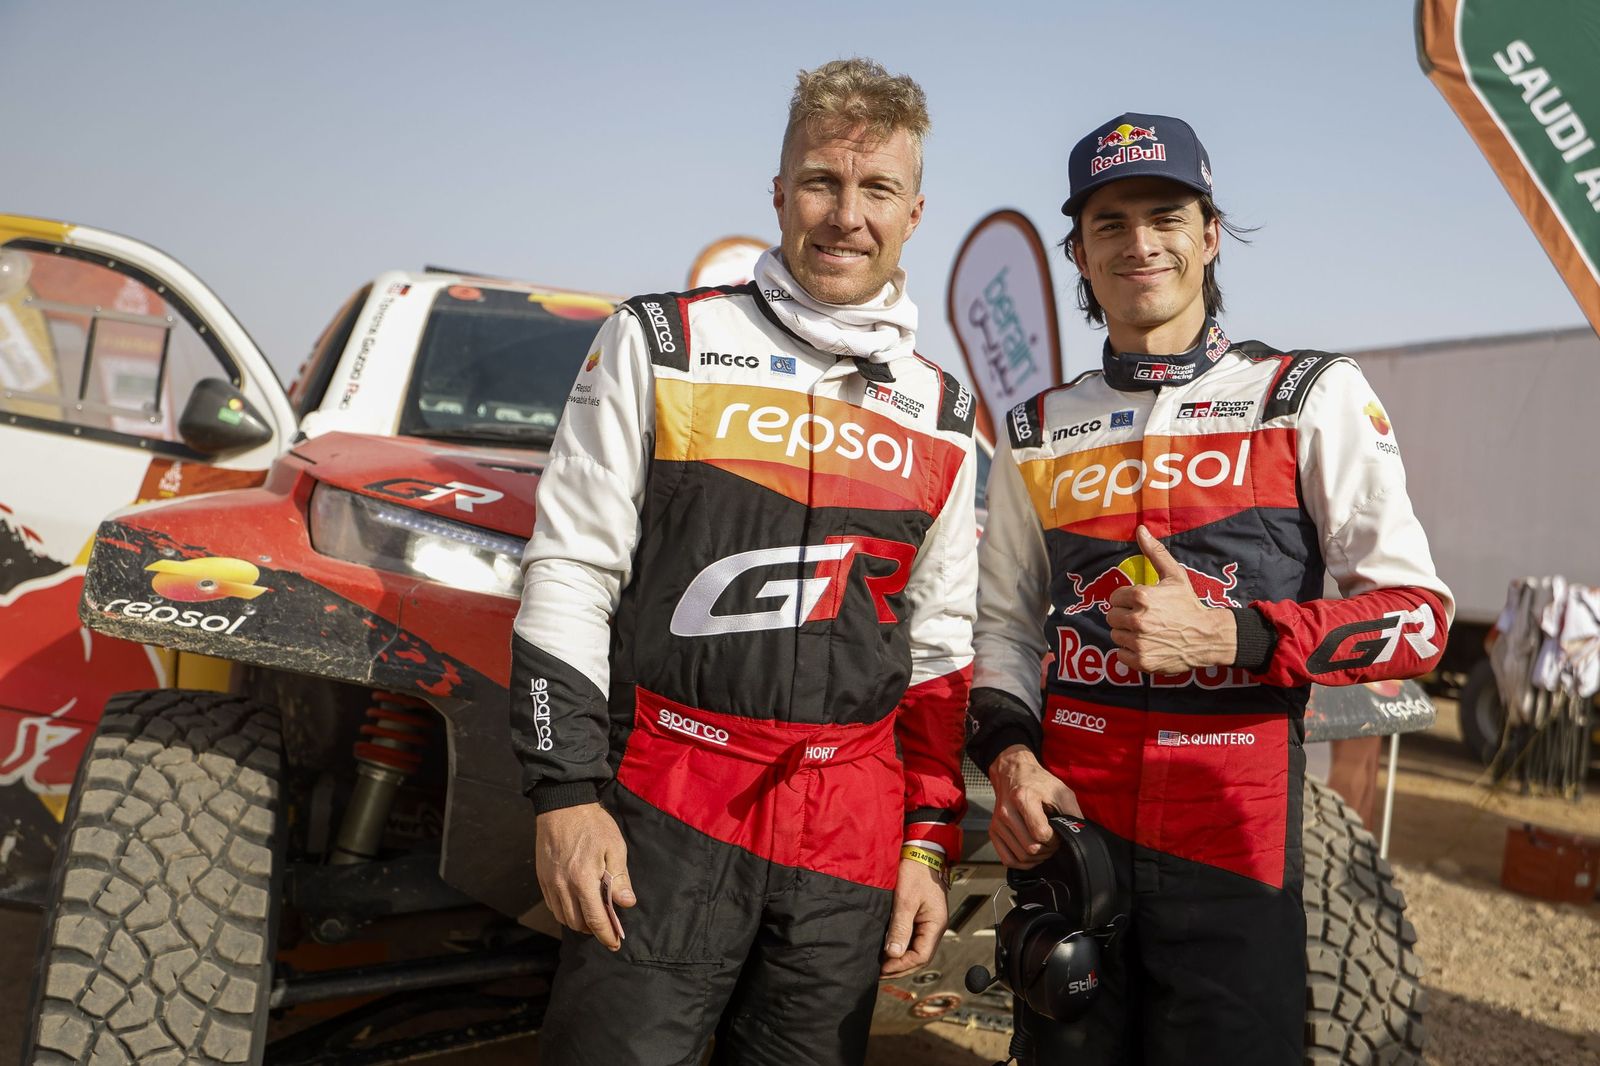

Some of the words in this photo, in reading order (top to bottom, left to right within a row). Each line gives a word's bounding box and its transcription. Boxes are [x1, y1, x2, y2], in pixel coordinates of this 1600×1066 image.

[1493, 40, 1595, 163] SAUDI
[1574, 166, 1600, 212] A
[1091, 147, 1126, 176] Red
[1127, 143, 1166, 162] Bull
[642, 302, 676, 353] sparco
[1136, 369, 1164, 379] GR
[1276, 356, 1322, 401] sparco
[865, 386, 890, 403] GR
[891, 400, 919, 419] Racing
[892, 395, 921, 413] GAZOO
[894, 390, 925, 410] TOYOTA
[1178, 407, 1209, 418] GR
[715, 402, 914, 479] repsol
[1050, 439, 1250, 509] repsol
[363, 478, 505, 512] GR
[669, 535, 918, 637] GR
[1306, 603, 1439, 674] GR
[530, 678, 553, 751] sparco
[657, 708, 729, 746] sparco
[1052, 708, 1107, 734] sparco
[1180, 733, 1255, 746] S.QUINTERO
[1068, 970, 1099, 995] Stilo
